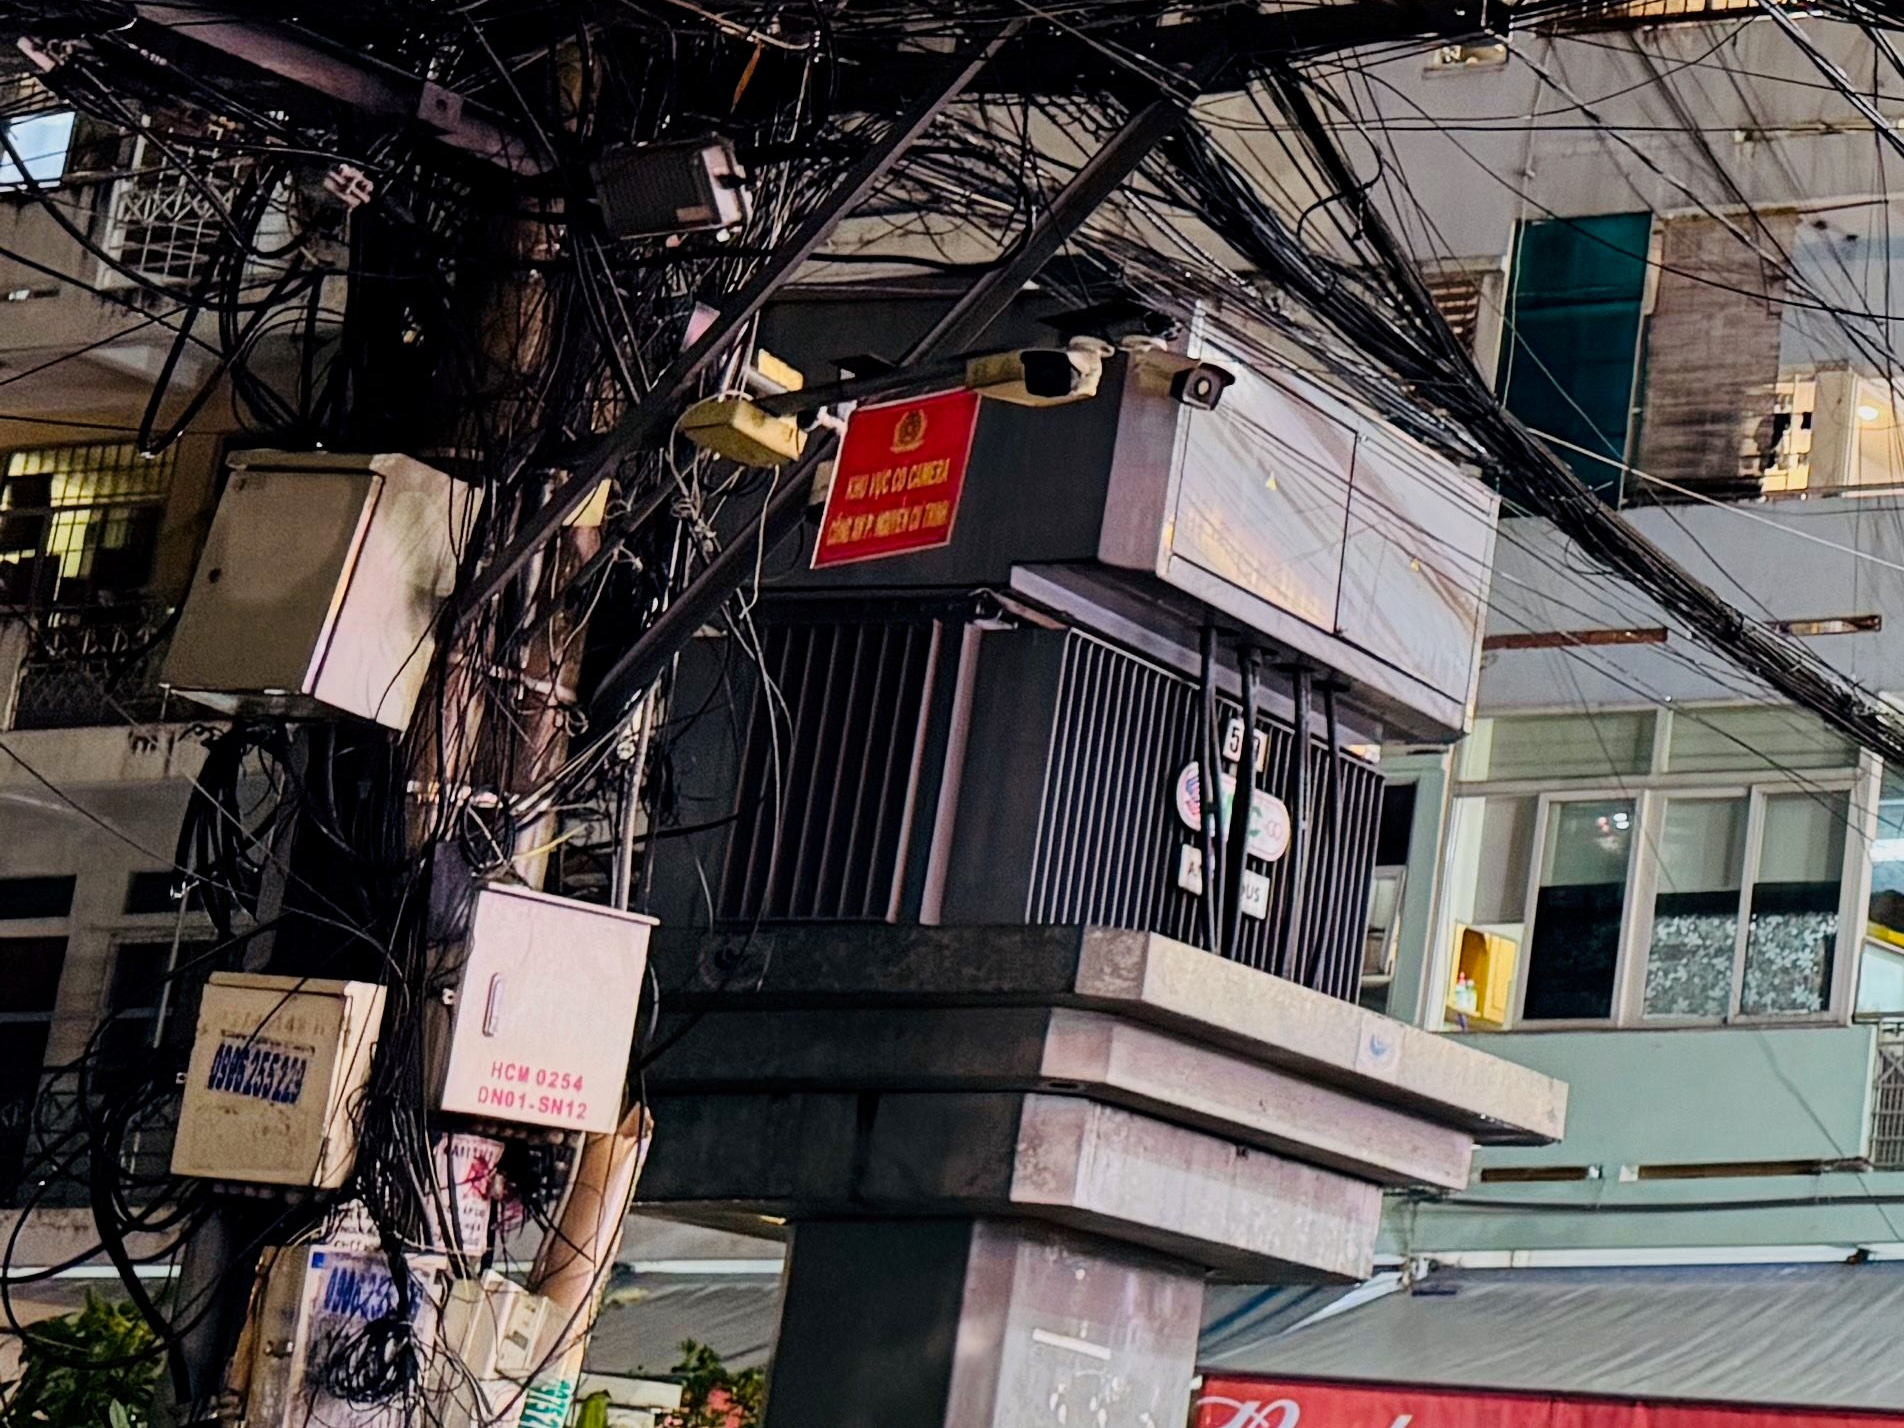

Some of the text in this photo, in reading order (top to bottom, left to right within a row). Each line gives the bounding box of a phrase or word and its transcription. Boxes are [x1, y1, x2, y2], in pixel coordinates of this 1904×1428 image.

[491, 1059, 585, 1093] HCM 0254
[477, 1083, 589, 1121] DN01-SN12
